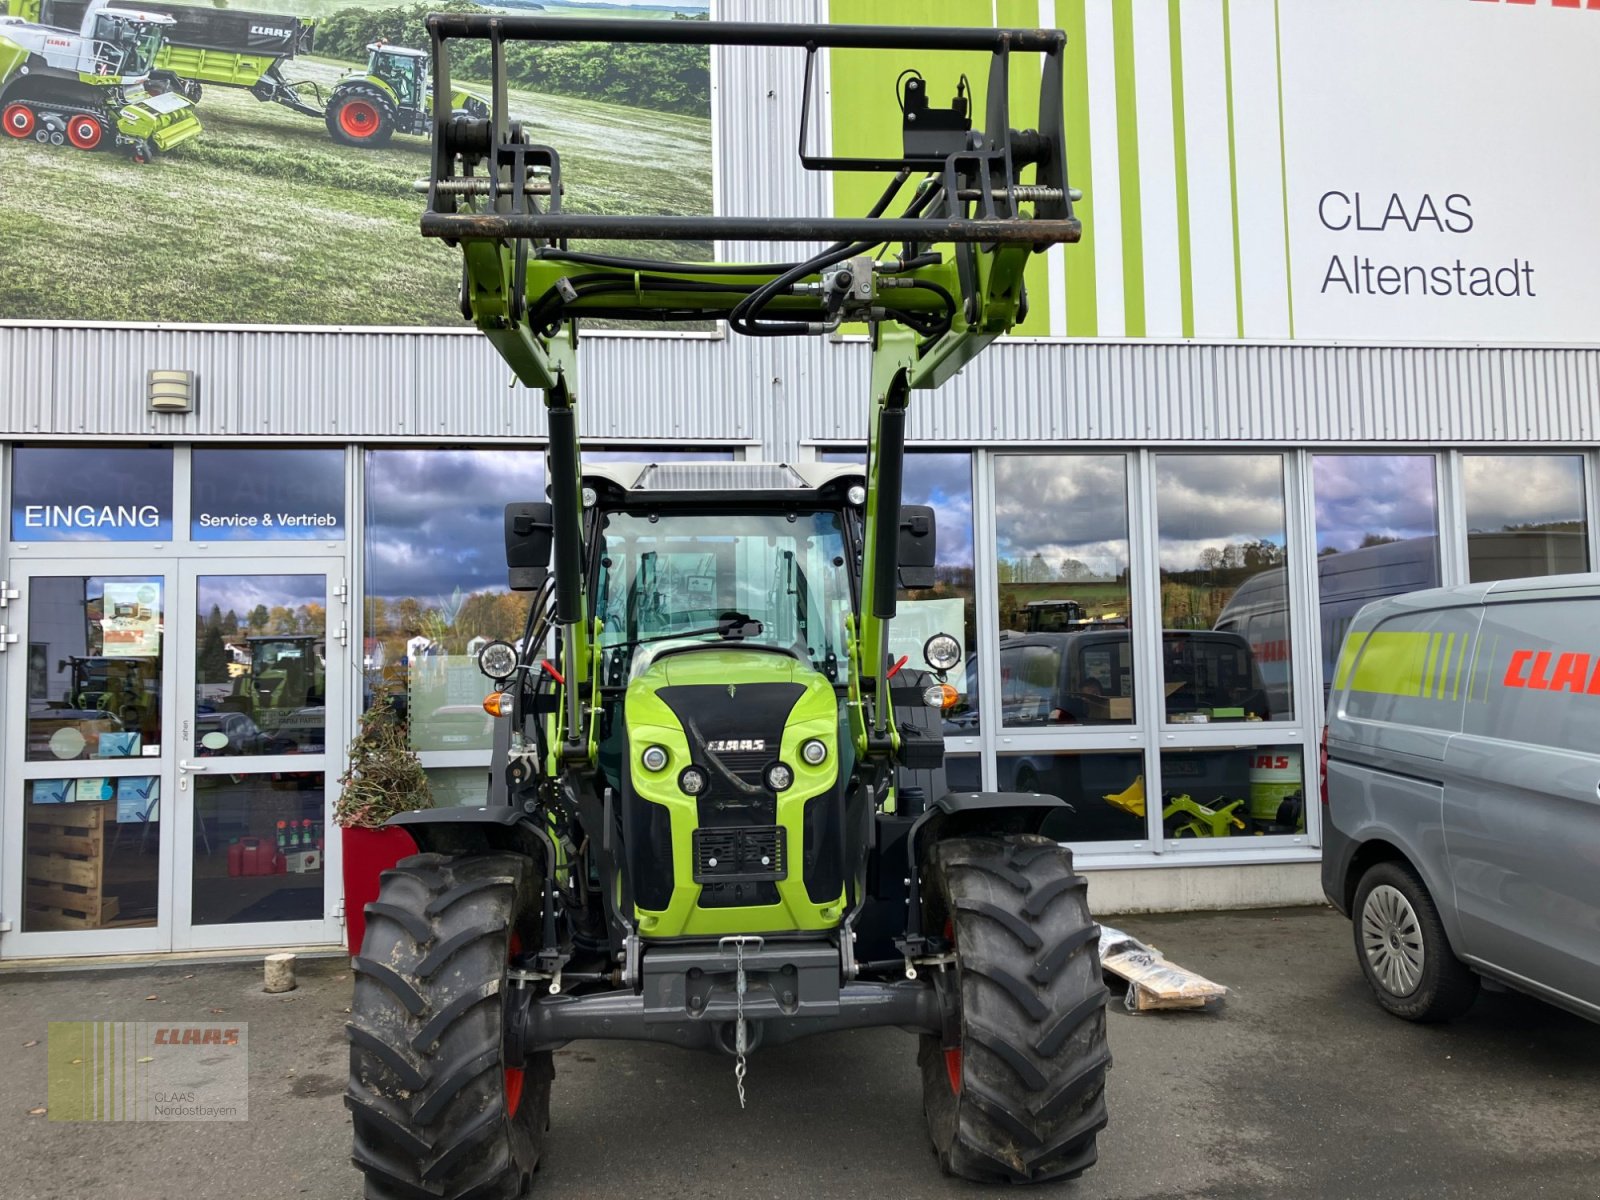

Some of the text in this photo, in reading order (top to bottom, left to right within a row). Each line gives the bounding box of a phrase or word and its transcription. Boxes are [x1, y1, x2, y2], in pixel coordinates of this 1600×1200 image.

[250, 25, 292, 38] CLAAS
[1317, 190, 1474, 233] CLAAS
[1320, 254, 1536, 297] Altenstadt
[24, 504, 160, 528] EINGANG
[199, 513, 337, 527] Service & Vertrieb
[707, 739, 765, 751] CLAAS
[1249, 754, 1289, 769] AS
